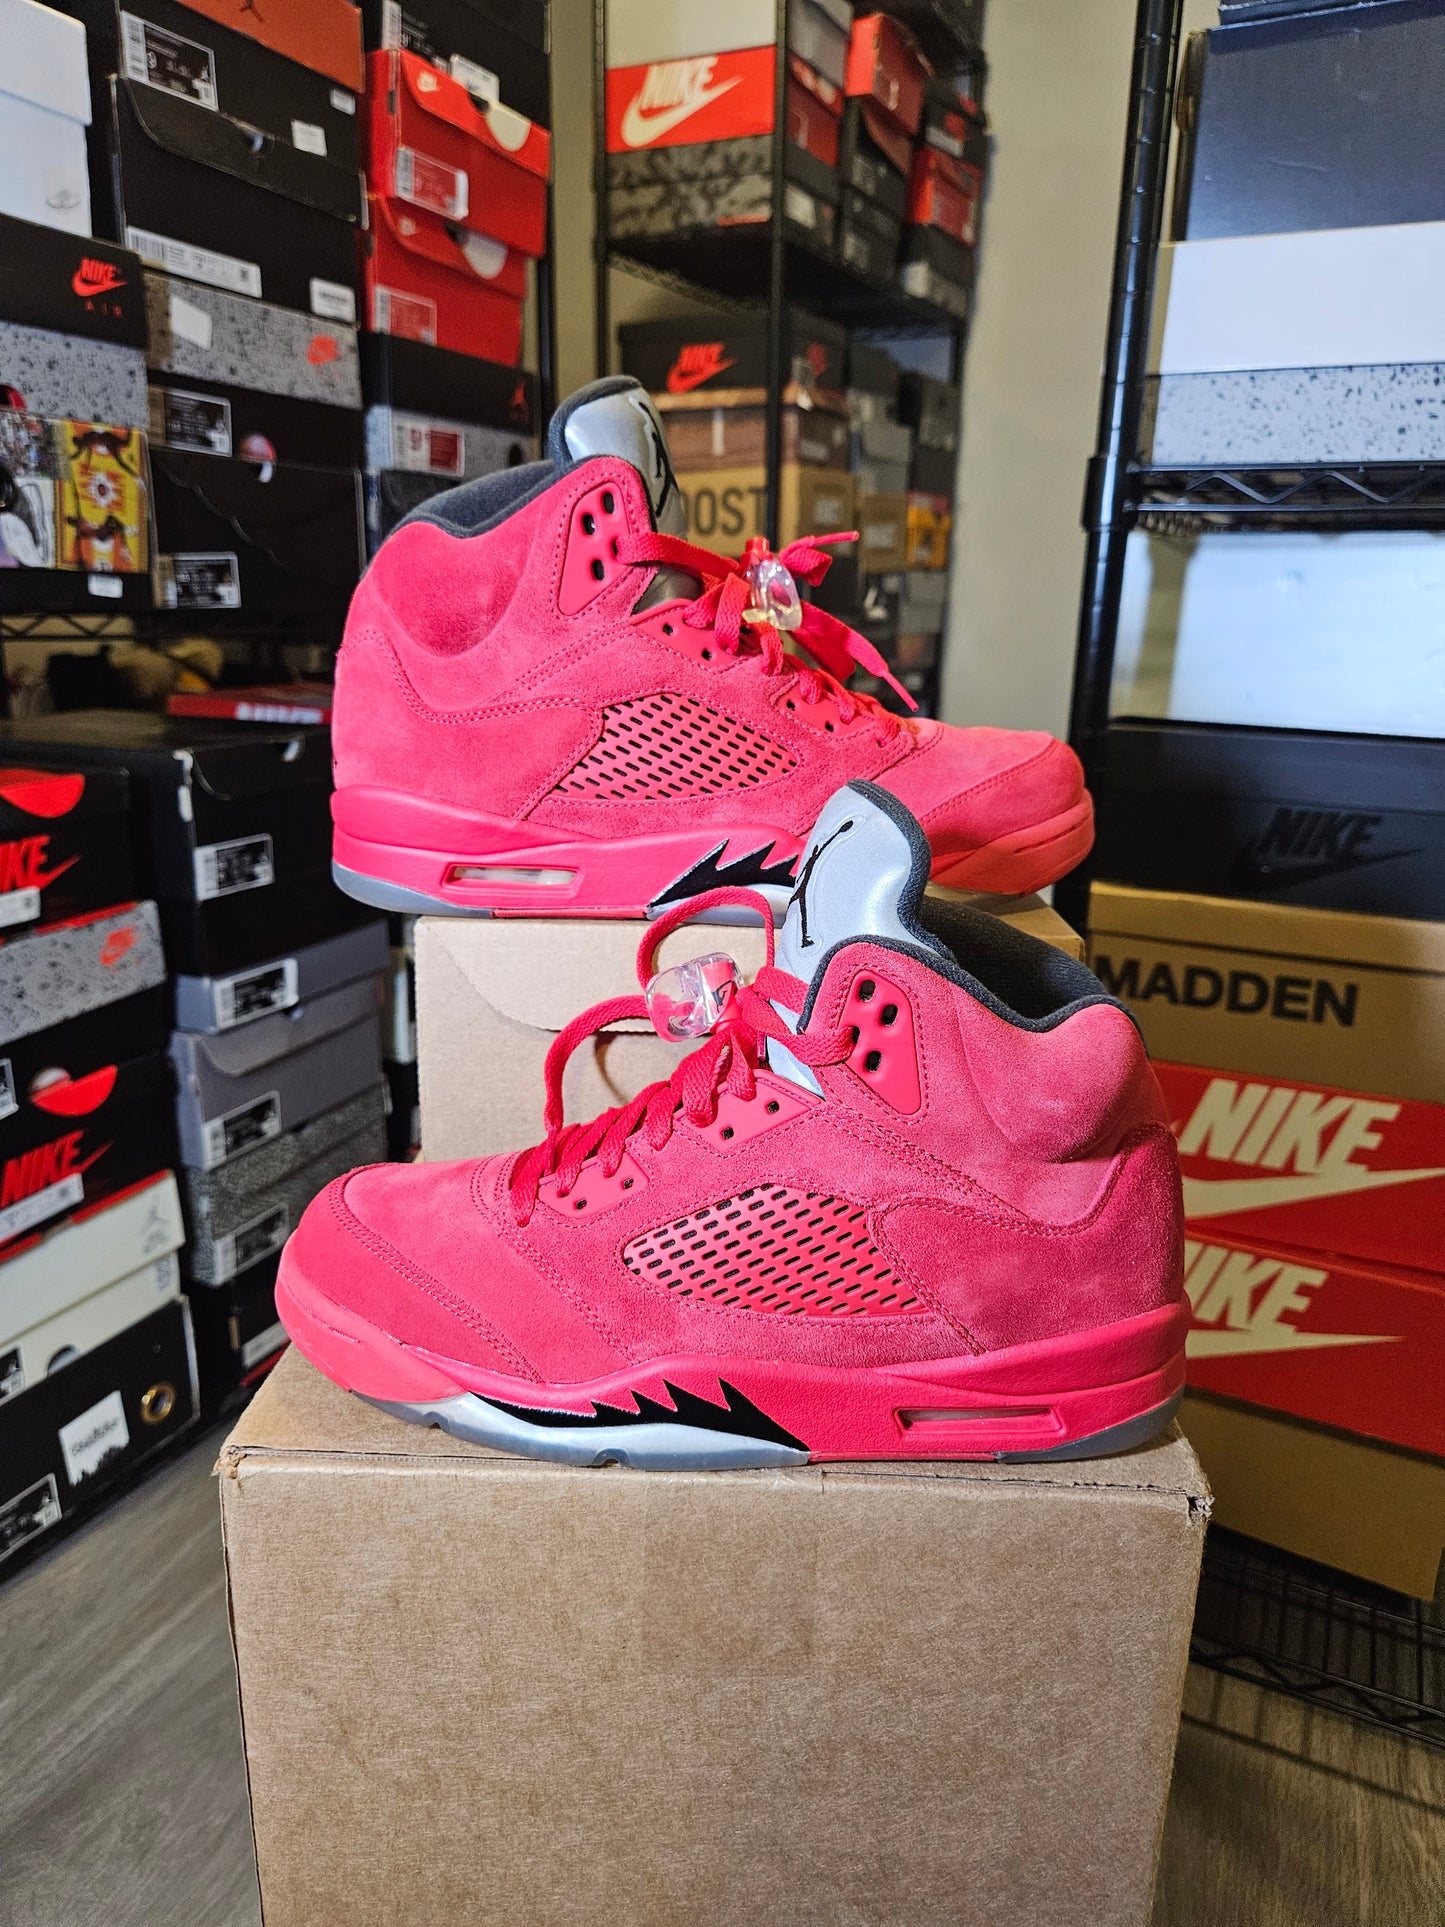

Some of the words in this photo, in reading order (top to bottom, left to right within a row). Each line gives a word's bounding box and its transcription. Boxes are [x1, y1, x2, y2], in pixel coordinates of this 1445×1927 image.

[638, 54, 719, 110] NIKE
[80, 256, 120, 284] NIKE
[680, 486, 767, 537] OST
[1258, 807, 1383, 860] NIKE
[0, 834, 50, 893] IKE
[1094, 955, 1359, 1028] MADDEN
[1178, 1077, 1401, 1173] NIKE
[0, 1130, 84, 1210] NIKE
